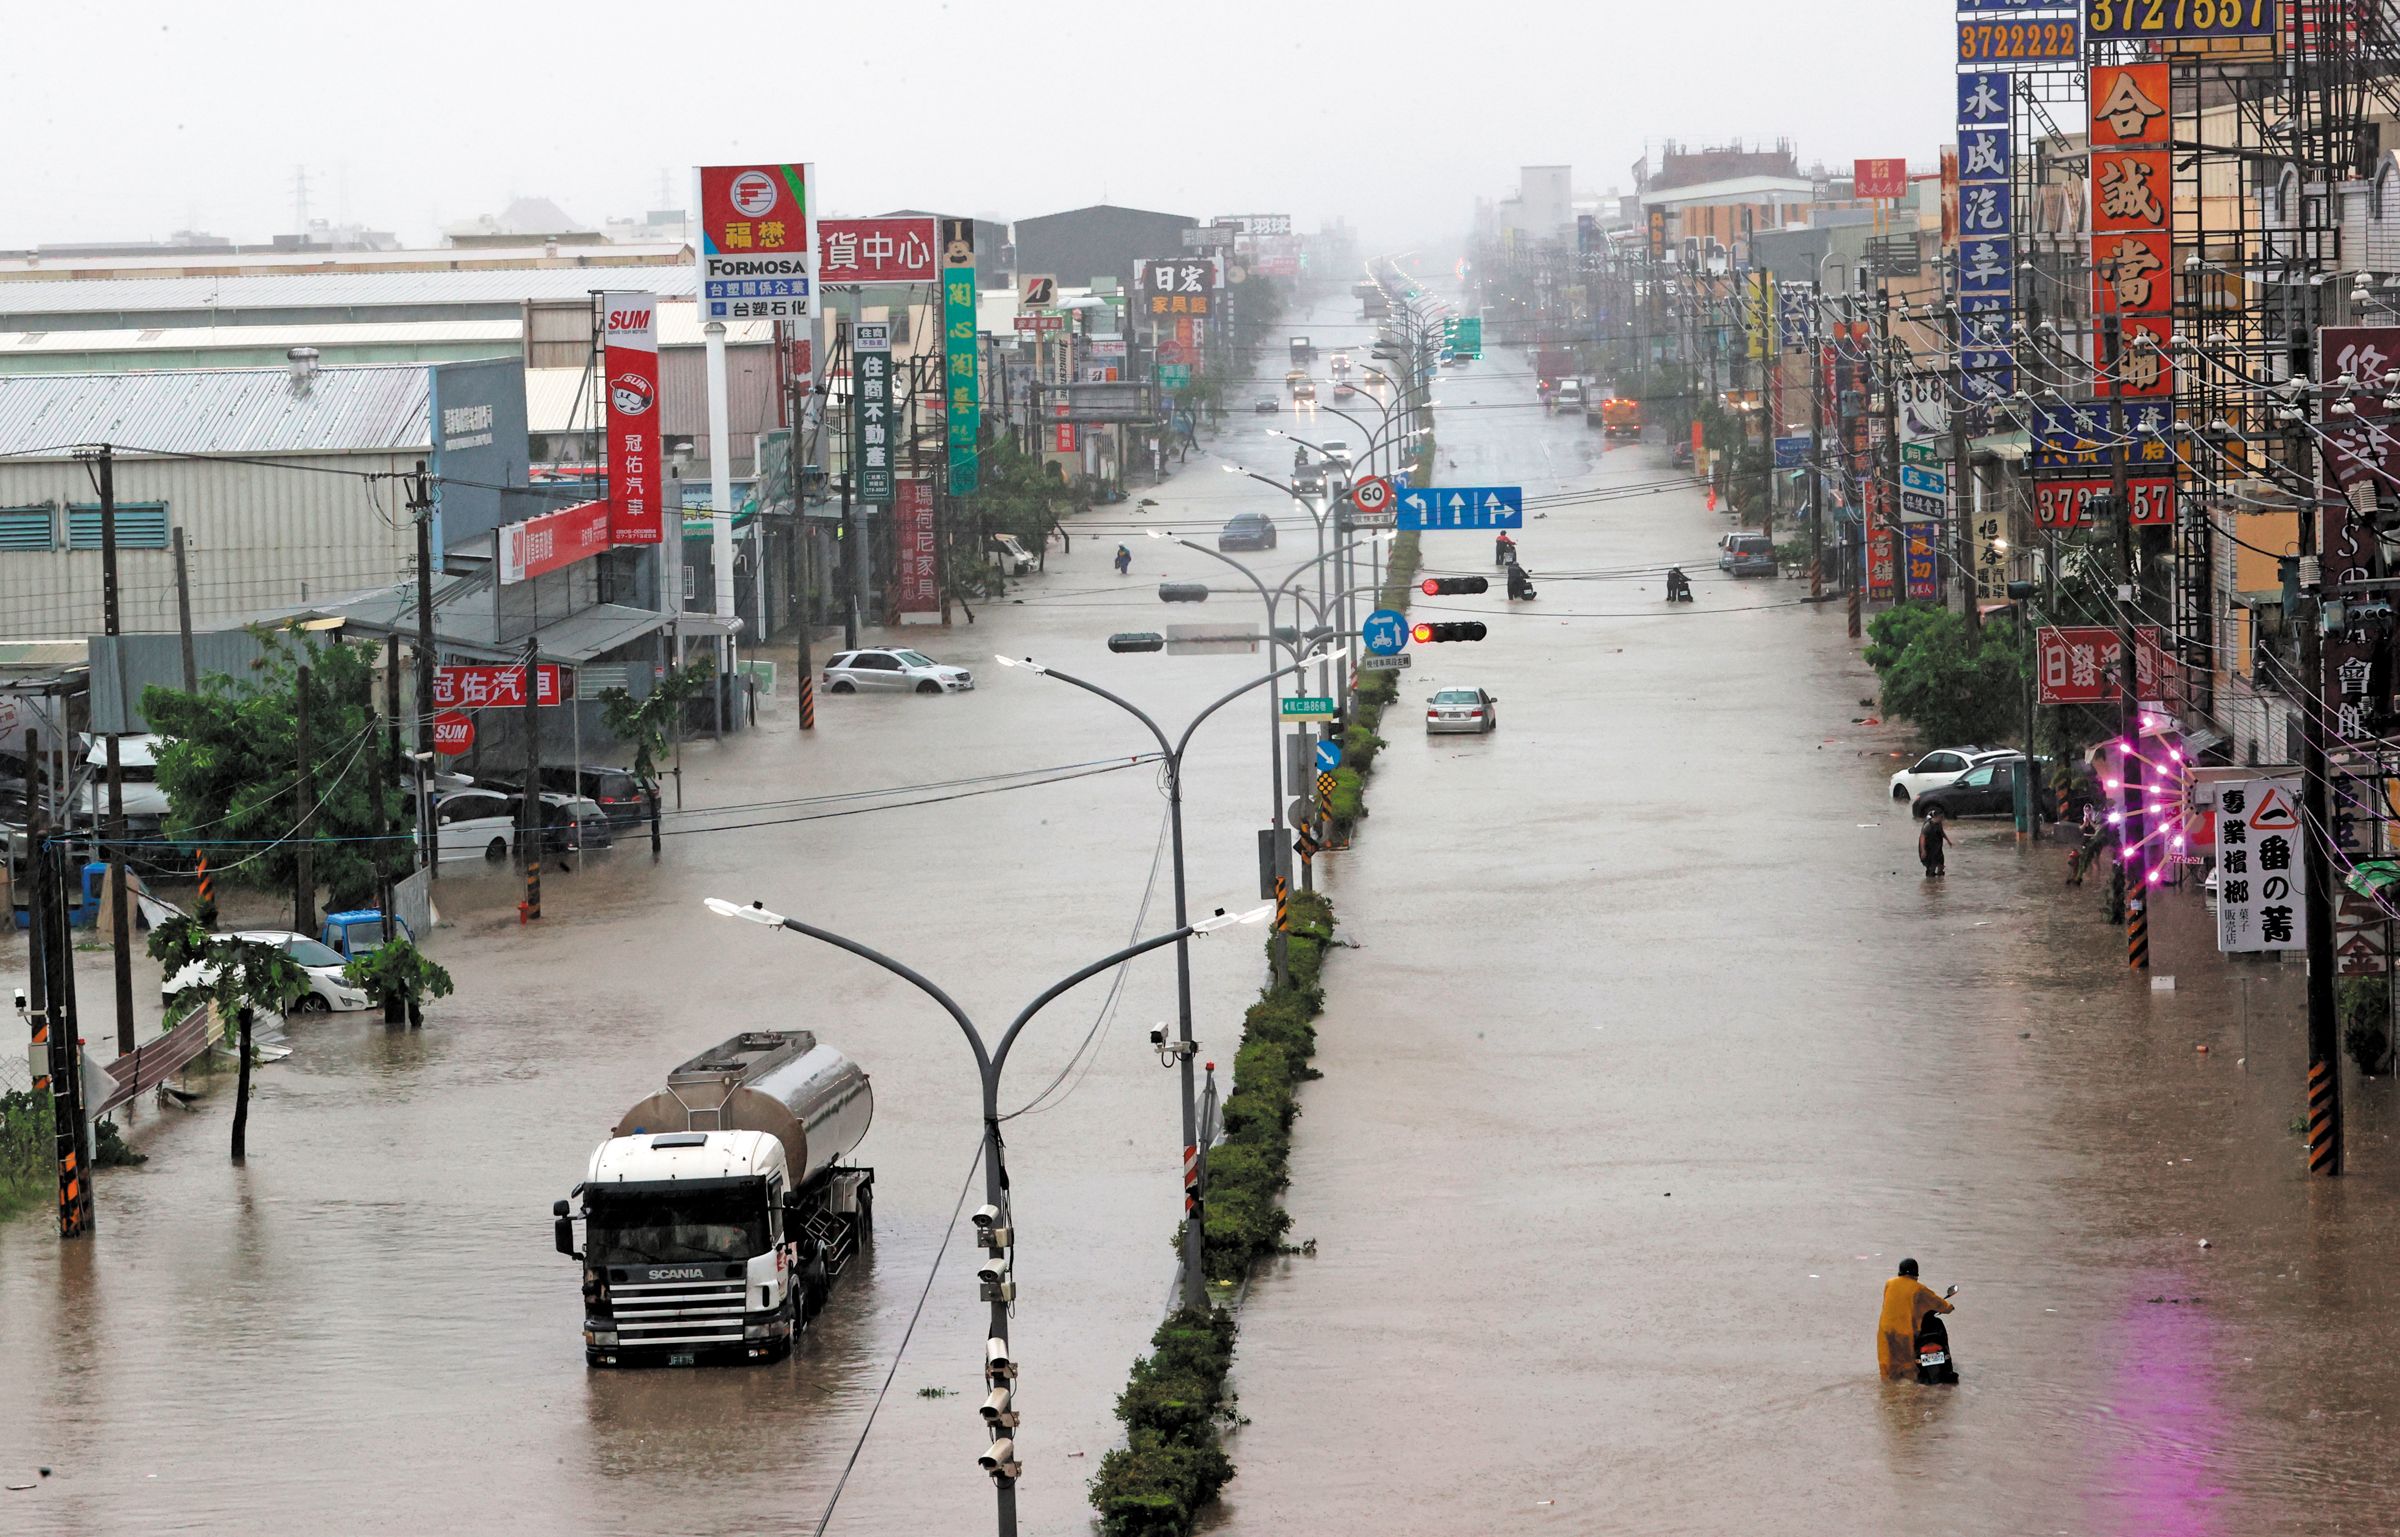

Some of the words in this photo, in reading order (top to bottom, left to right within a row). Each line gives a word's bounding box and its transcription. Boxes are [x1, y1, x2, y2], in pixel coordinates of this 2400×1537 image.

[2090, 0, 2262, 31] 3727557
[1961, 22, 2075, 59] 3722222
[725, 221, 785, 249] 福懋
[818, 230, 931, 271] 貨中心
[708, 258, 807, 276] FORMOSA
[1155, 265, 1205, 293] 日宏
[710, 280, 804, 297] 台塑關係企業
[733, 301, 807, 317] 台塑石化
[1151, 296, 1207, 313] 家具館
[608, 310, 651, 330] SUM
[861, 328, 883, 338] 住商
[624, 374, 647, 391] SUM
[862, 356, 886, 467] 住商不動產
[625, 434, 644, 516] 冠佑汽車
[1361, 487, 1382, 501] 60
[2040, 485, 2168, 522] 37257
[914, 485, 936, 600] 瑪荷尼家具
[1910, 523, 1933, 578] 親切
[433, 671, 552, 701] 冠佑汽車
[435, 725, 468, 739] SUM
[2222, 790, 2249, 904] 專業檳榔
[2239, 908, 2250, 932] 菓子
[649, 1269, 704, 1280] SCANIA
